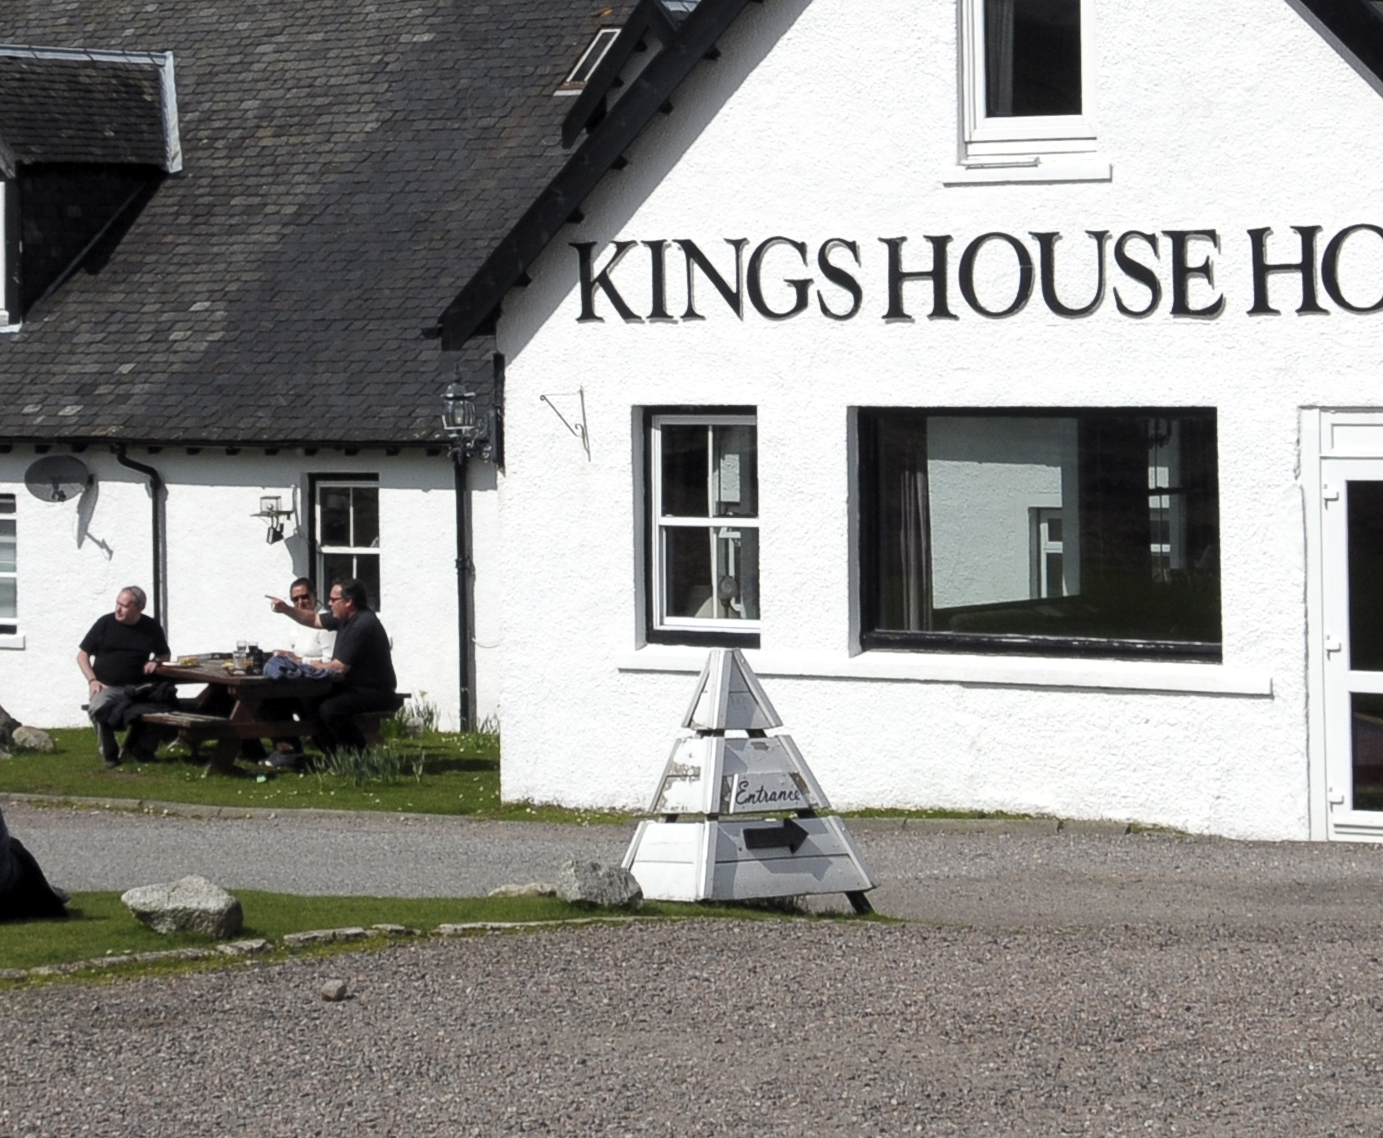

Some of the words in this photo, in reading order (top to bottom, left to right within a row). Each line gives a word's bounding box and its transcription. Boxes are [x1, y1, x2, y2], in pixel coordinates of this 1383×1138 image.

[569, 237, 863, 324] KINGS
[882, 229, 1226, 322] HOUSE
[735, 780, 801, 806] Entrance
